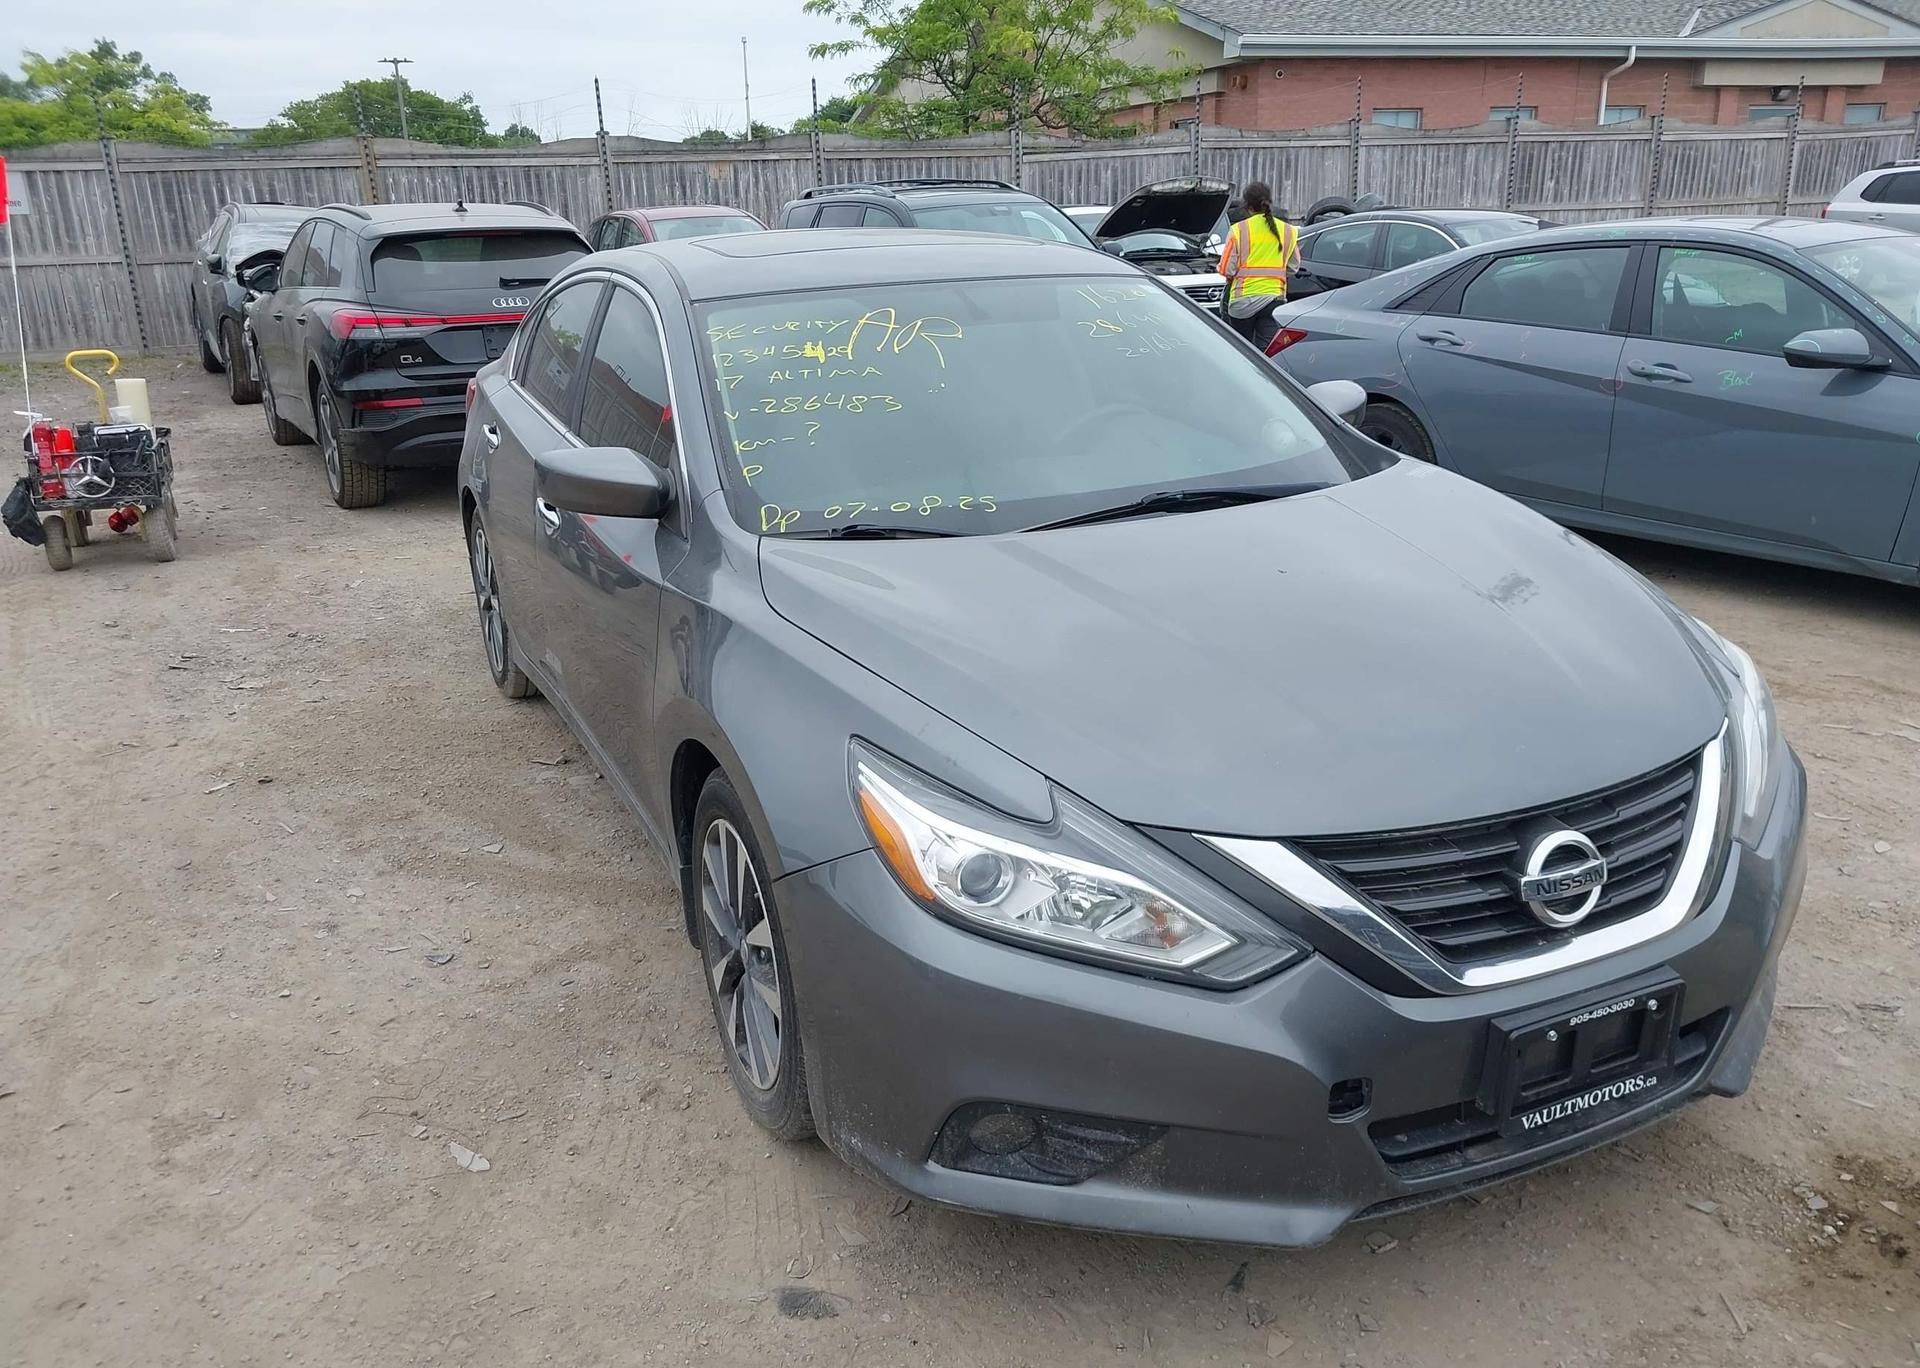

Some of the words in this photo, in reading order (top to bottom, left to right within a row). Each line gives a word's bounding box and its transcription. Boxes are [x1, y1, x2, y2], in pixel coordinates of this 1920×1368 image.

[706, 319, 850, 343] SECURITY
[714, 375, 744, 392] 17
[768, 365, 883, 385] ALTIMA
[1536, 867, 1605, 897] NISSAN
[1568, 998, 1636, 1027] 905-450-3030
[1521, 1074, 1658, 1130] VAULTMOTORS.ca
